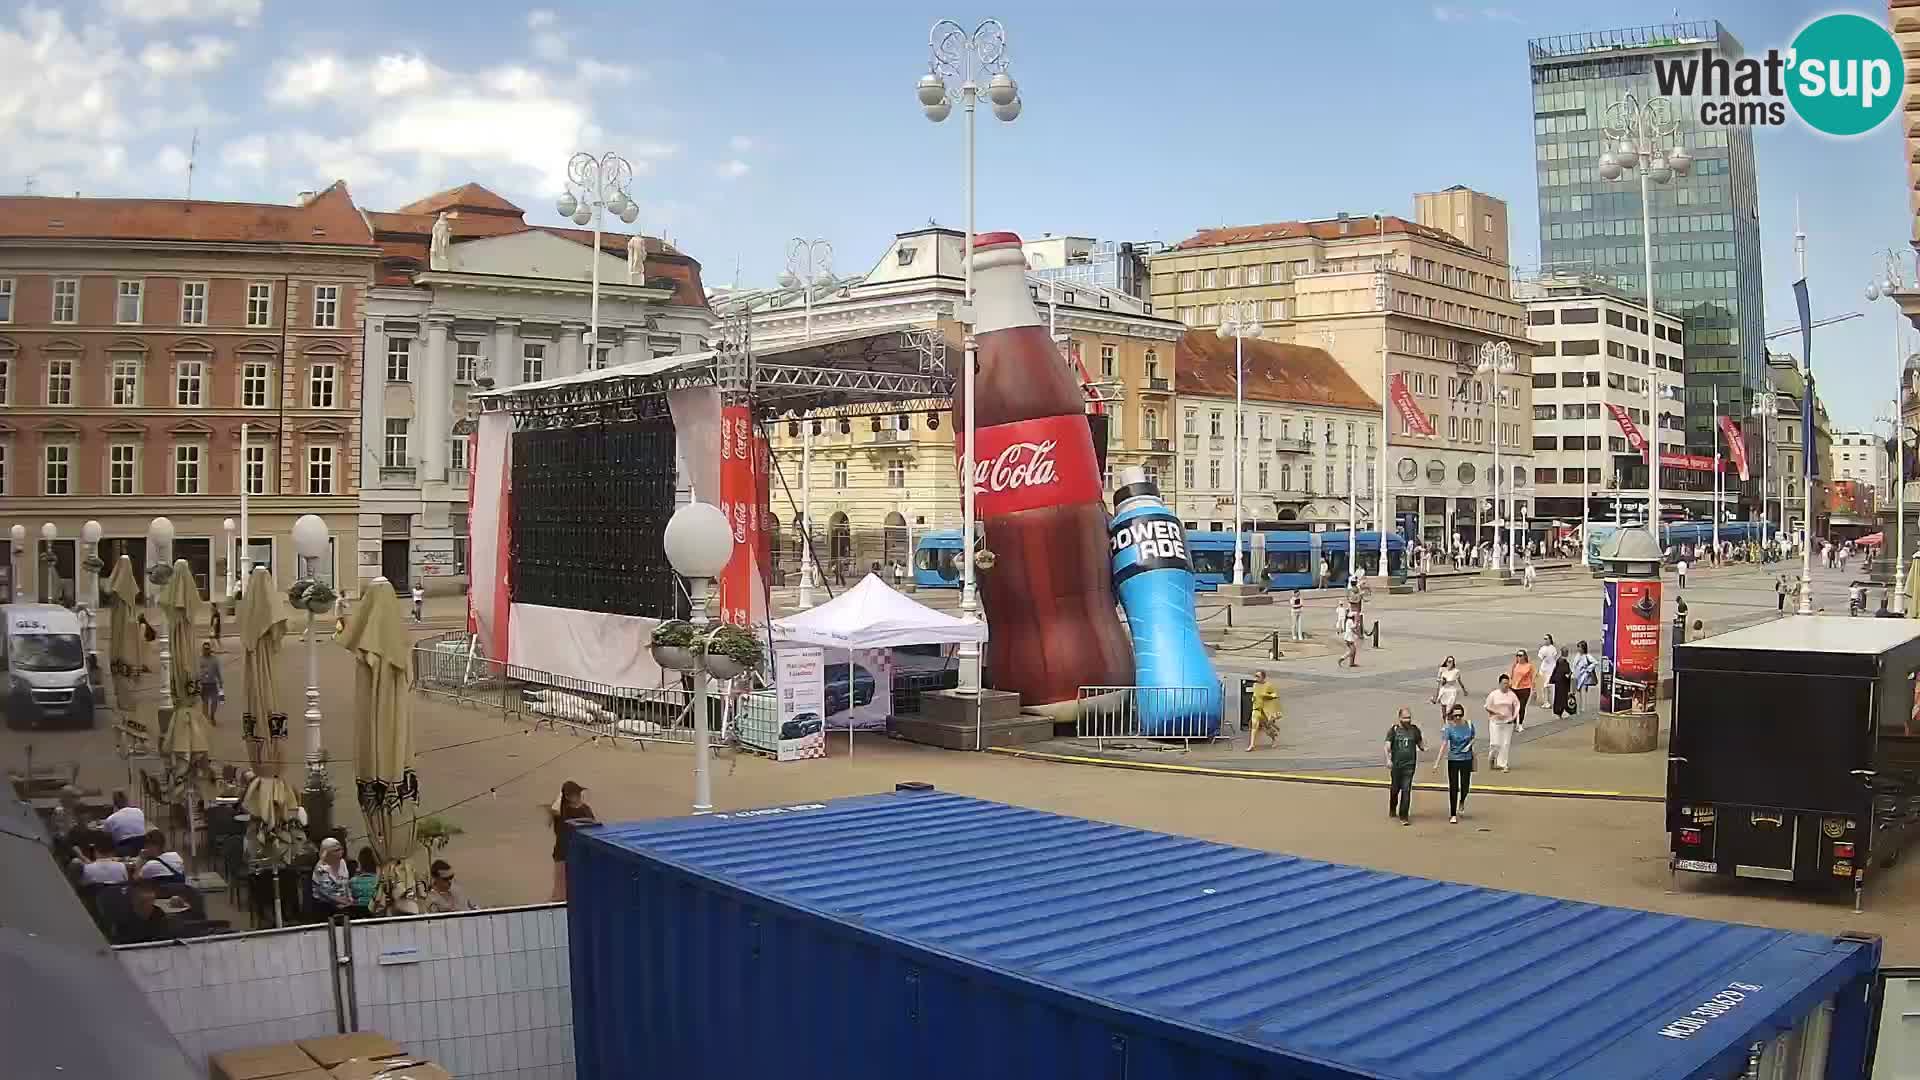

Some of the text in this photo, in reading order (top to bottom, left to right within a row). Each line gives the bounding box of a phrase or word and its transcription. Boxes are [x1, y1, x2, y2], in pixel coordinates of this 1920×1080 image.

[1140, 539, 1187, 560] ADE
[1657, 1016, 1708, 1040] MCDU
[1691, 990, 1746, 1019] 300629
